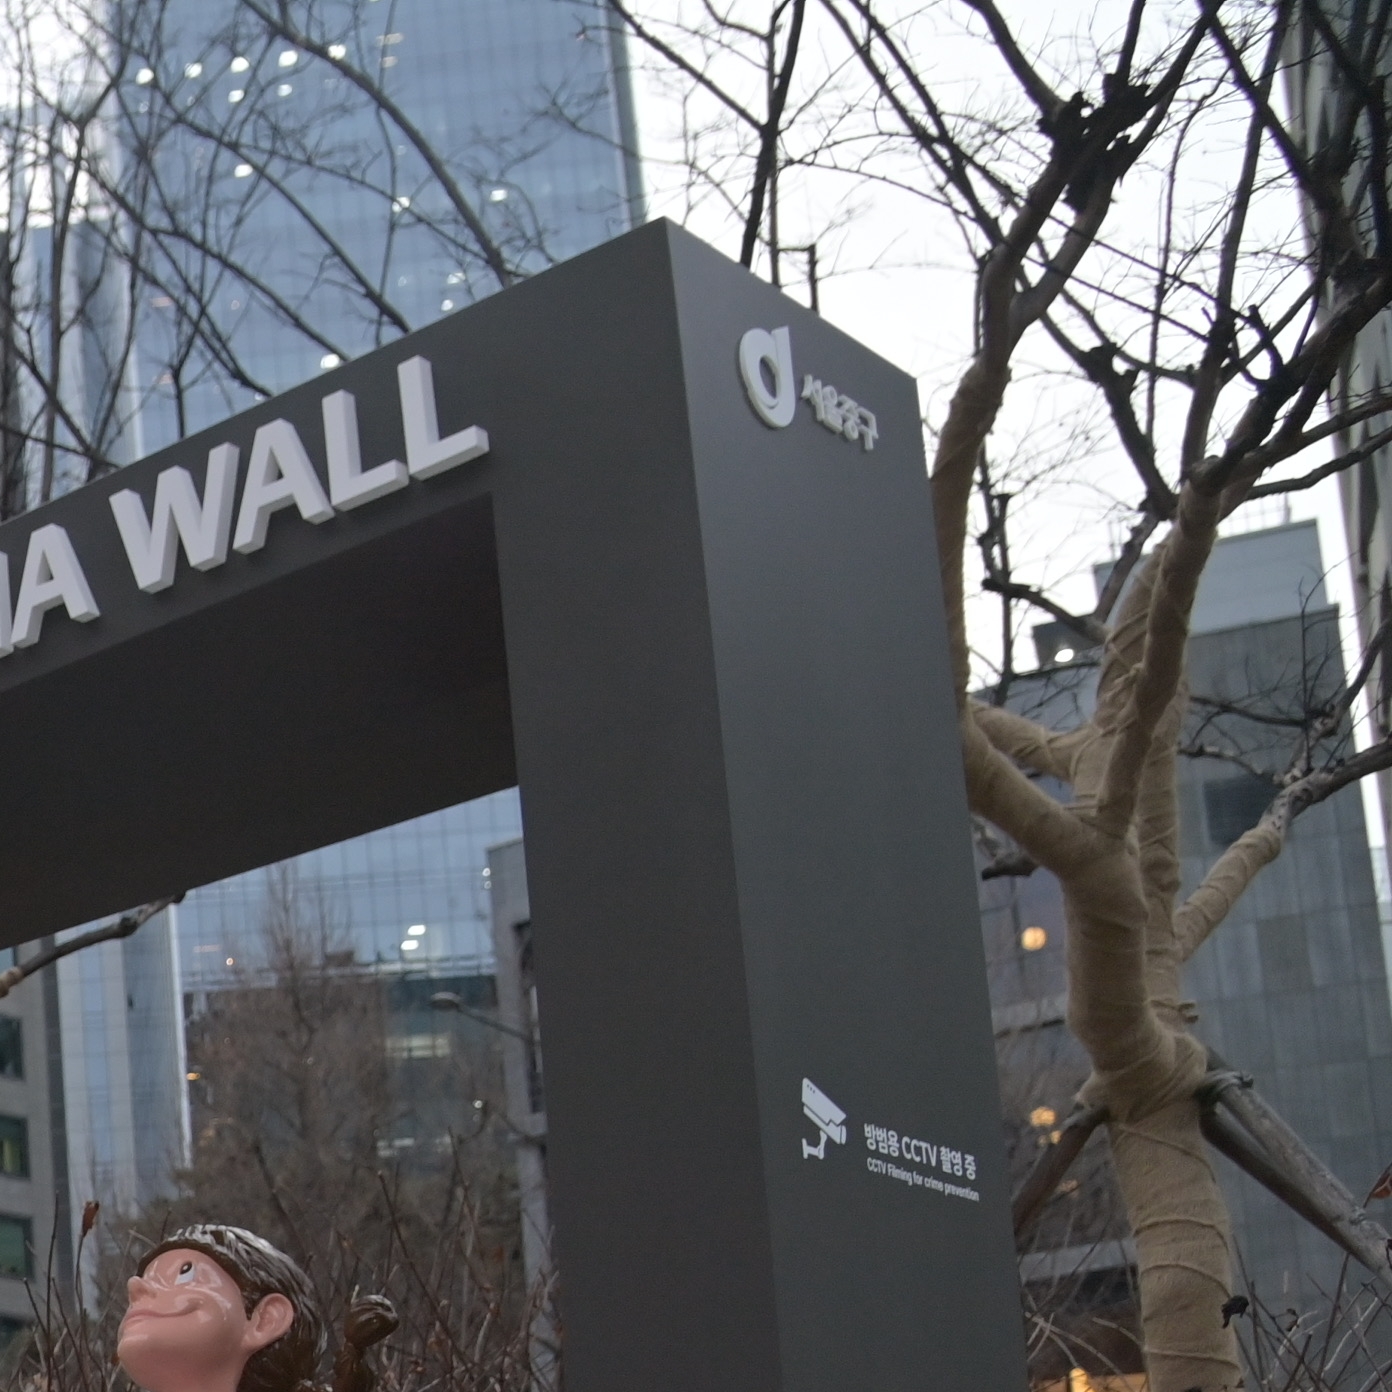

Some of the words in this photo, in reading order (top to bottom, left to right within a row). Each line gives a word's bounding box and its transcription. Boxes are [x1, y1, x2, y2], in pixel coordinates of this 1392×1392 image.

[800, 374, 879, 450] 서울중구
[109, 354, 490, 594] WALL
[864, 1123, 899, 1157] 방범용
[902, 1136, 937, 1166] CCTV
[867, 1157, 886, 1175] CCTV
[888, 1163, 912, 1186] Filming
[913, 1171, 923, 1185] for
[925, 1176, 943, 1192] crime
[945, 1182, 980, 1201] prevention
